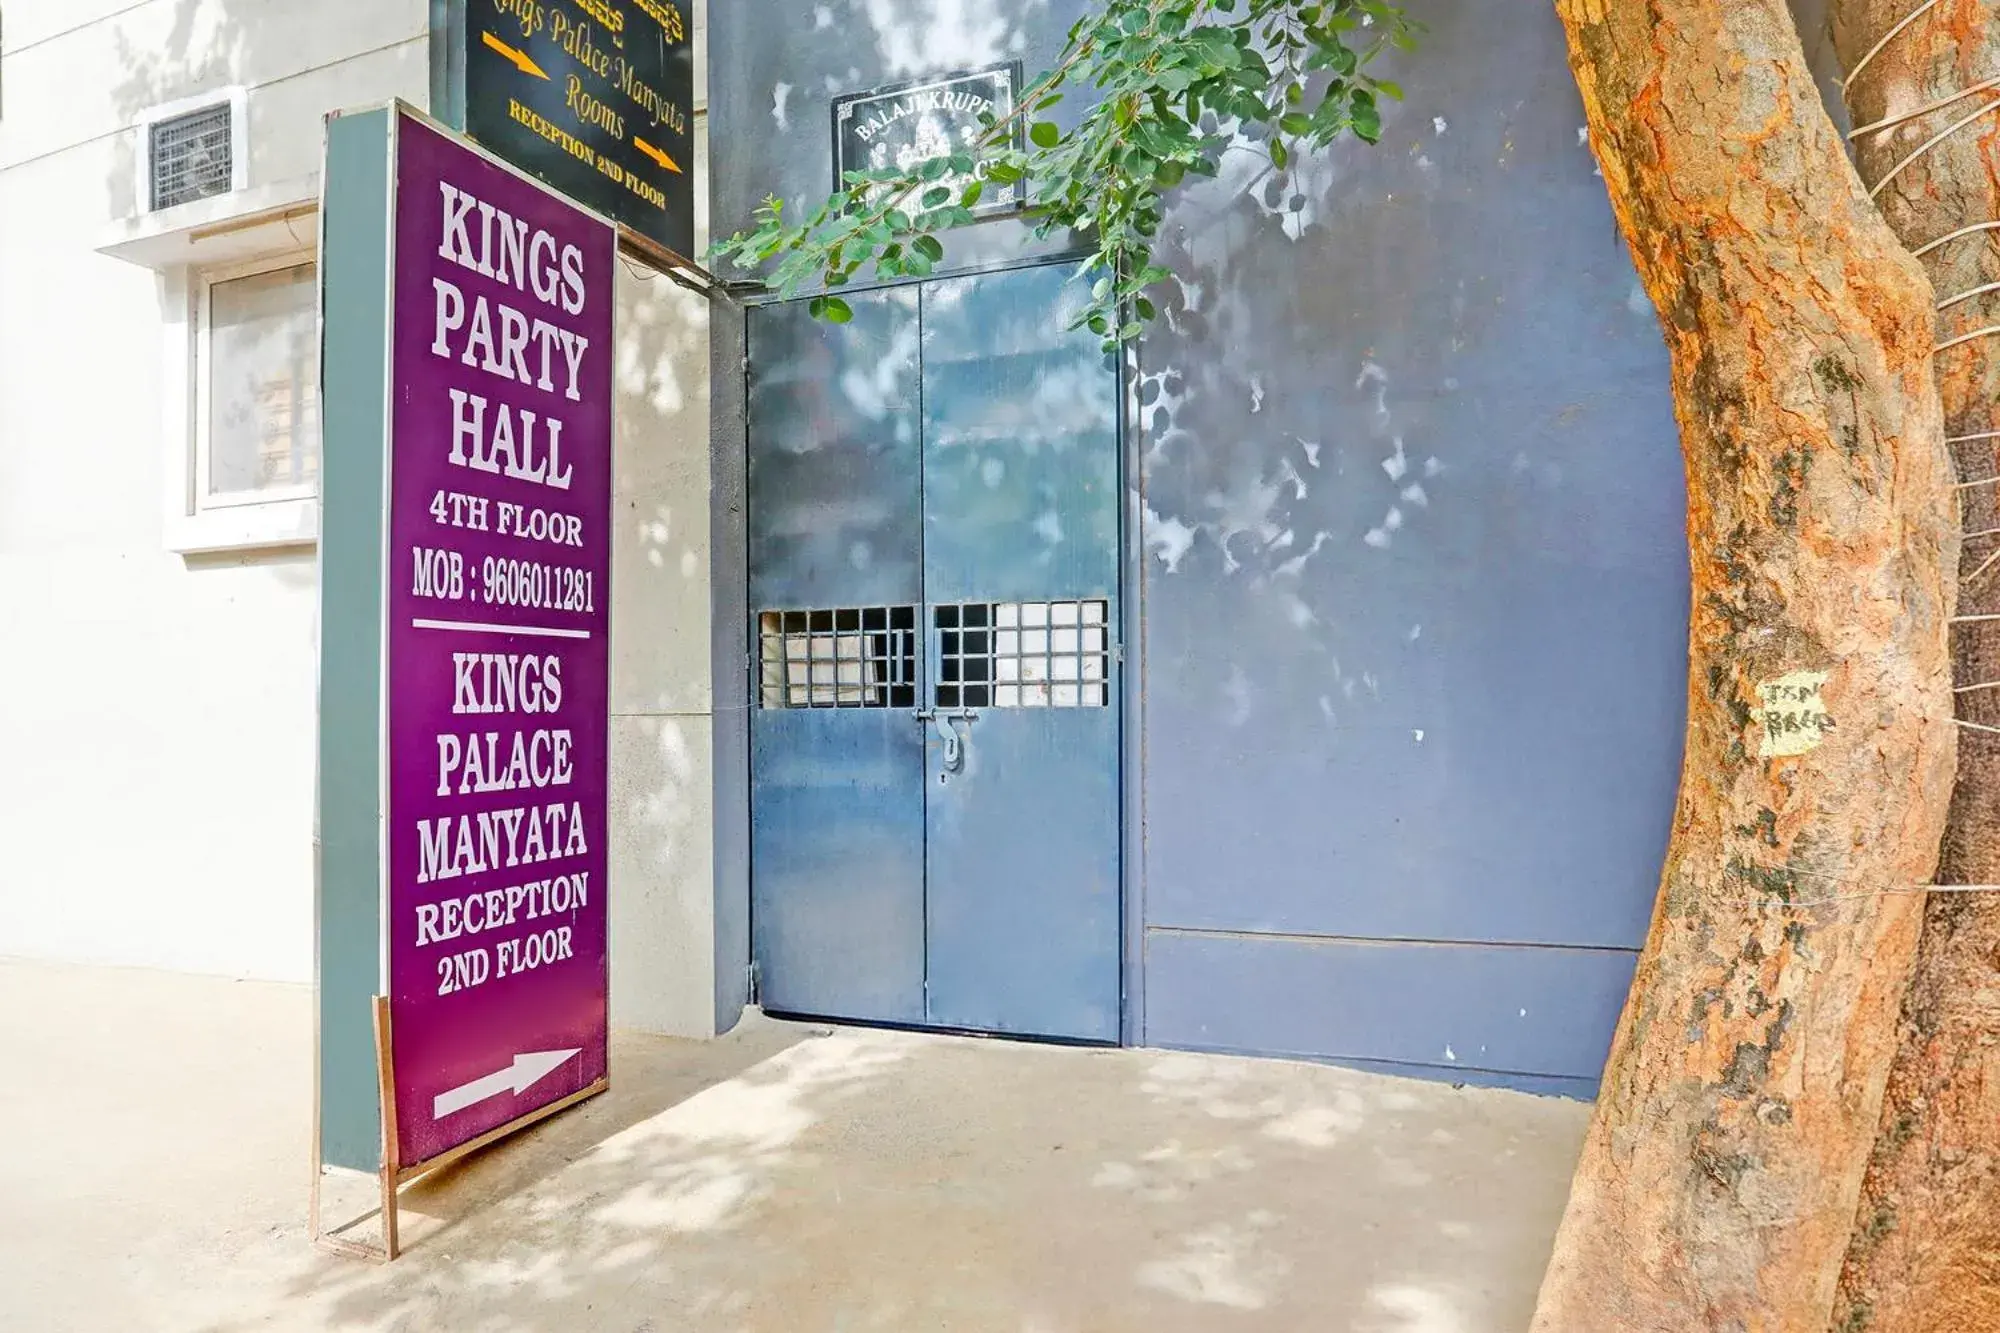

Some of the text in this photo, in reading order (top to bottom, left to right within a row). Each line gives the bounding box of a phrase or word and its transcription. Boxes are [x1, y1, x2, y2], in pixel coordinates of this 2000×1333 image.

[551, 9, 609, 77] Palace
[613, 56, 684, 136] Manyata
[566, 74, 625, 140] Rooms
[509, 98, 666, 211] RECEPTION 2ND FLOOR
[854, 95, 922, 141] BALAJI
[439, 180, 585, 315] KINGS
[431, 276, 588, 401] PARTY
[448, 387, 573, 490] HALL
[429, 490, 583, 547] 4TH FLOOR
[412, 546, 463, 600] MOB
[483, 556, 595, 613] 9606011281
[452, 652, 562, 714] KINGS
[436, 729, 573, 797] PALACE
[416, 801, 588, 884] MANYATA
[415, 872, 589, 947] RECEPTION
[437, 925, 573, 996] 2ND FLOOR
